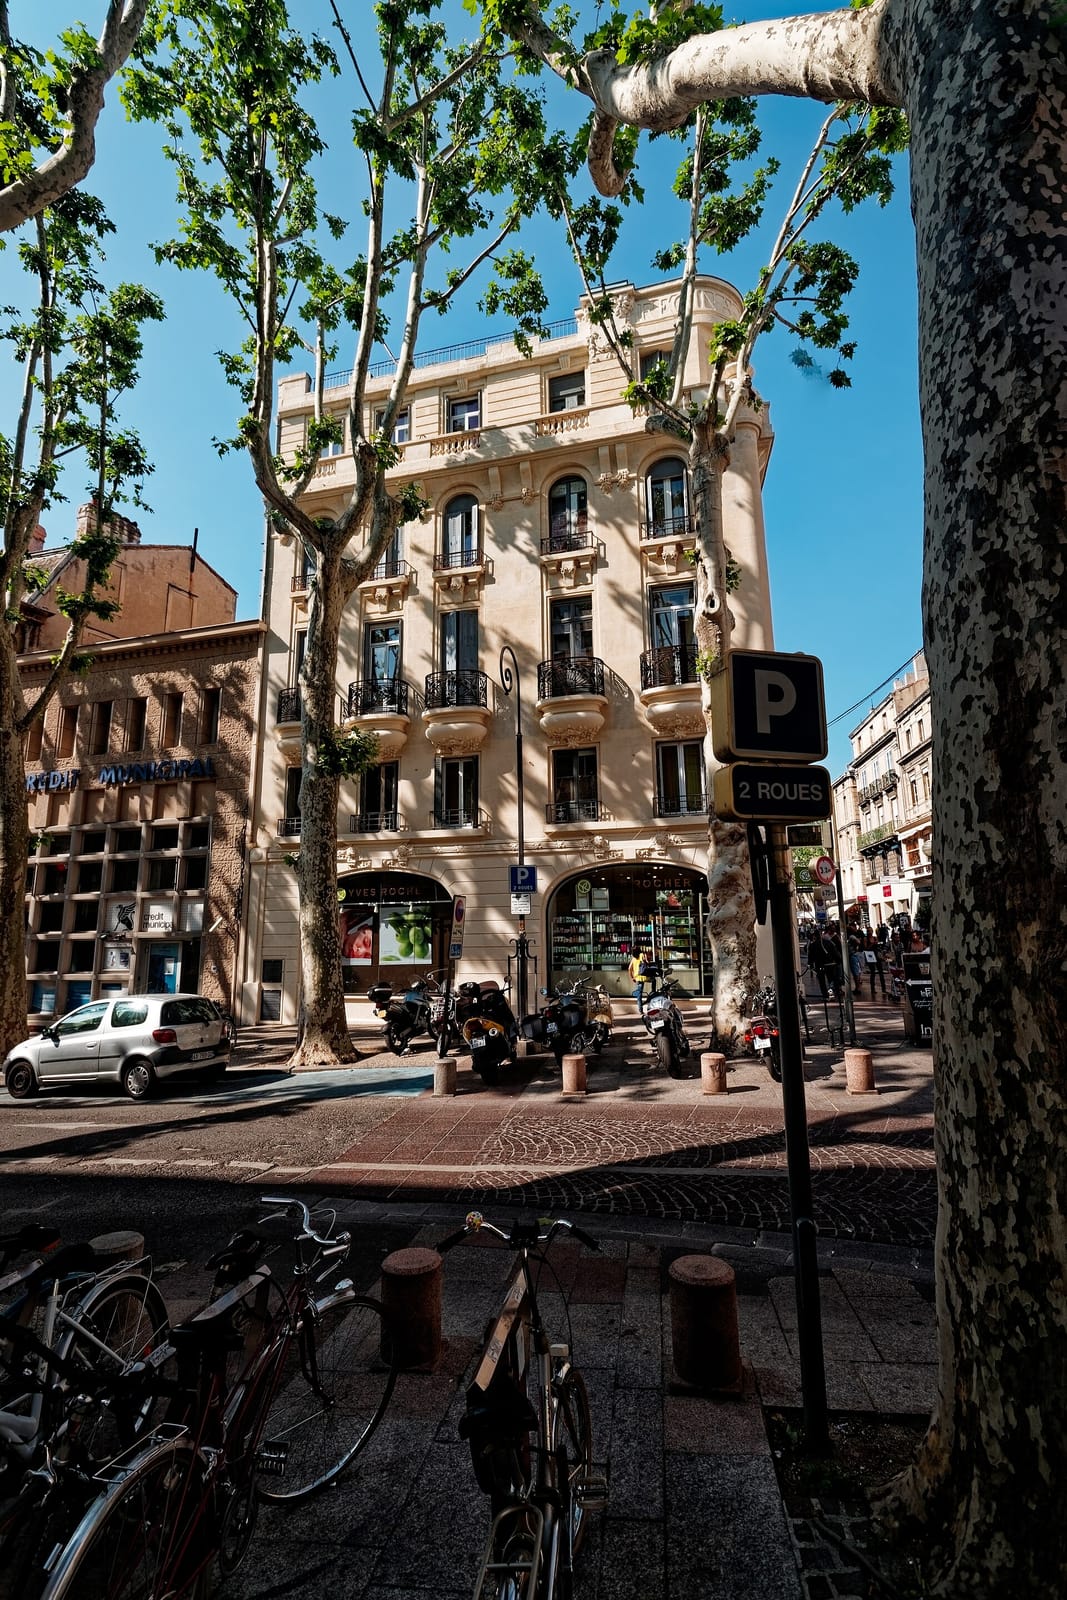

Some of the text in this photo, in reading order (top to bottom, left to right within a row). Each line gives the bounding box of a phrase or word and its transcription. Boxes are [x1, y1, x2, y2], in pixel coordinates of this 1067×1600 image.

[754, 668, 797, 734] P
[26, 756, 215, 791] REDIT MUNICIPAL
[739, 781, 823, 801] 2 ROUES
[517, 867, 529, 885] P
[348, 887, 377, 897] YVES
